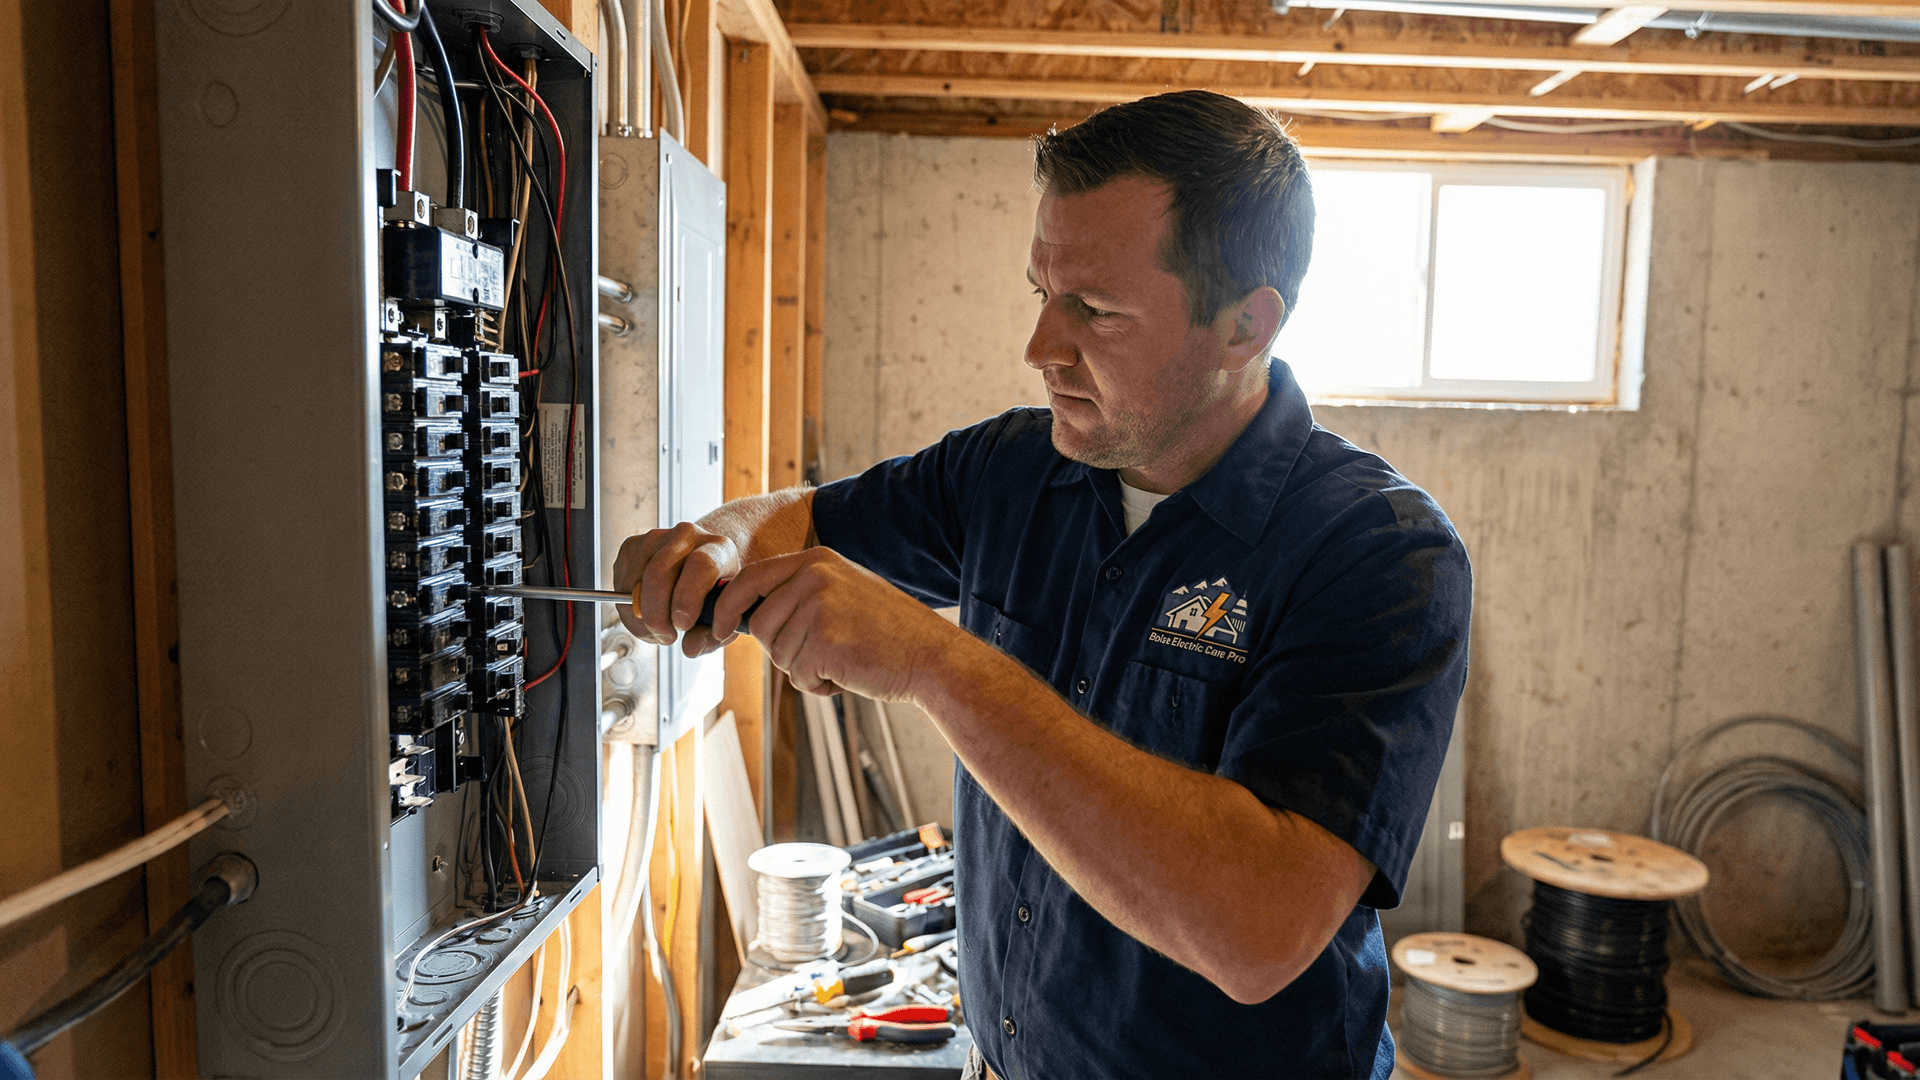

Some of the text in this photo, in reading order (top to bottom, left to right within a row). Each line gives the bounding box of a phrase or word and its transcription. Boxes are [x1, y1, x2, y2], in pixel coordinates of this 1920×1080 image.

[1171, 637, 1204, 653] Electric
[1204, 645, 1226, 659] Care
[1226, 651, 1246, 664] Pro
